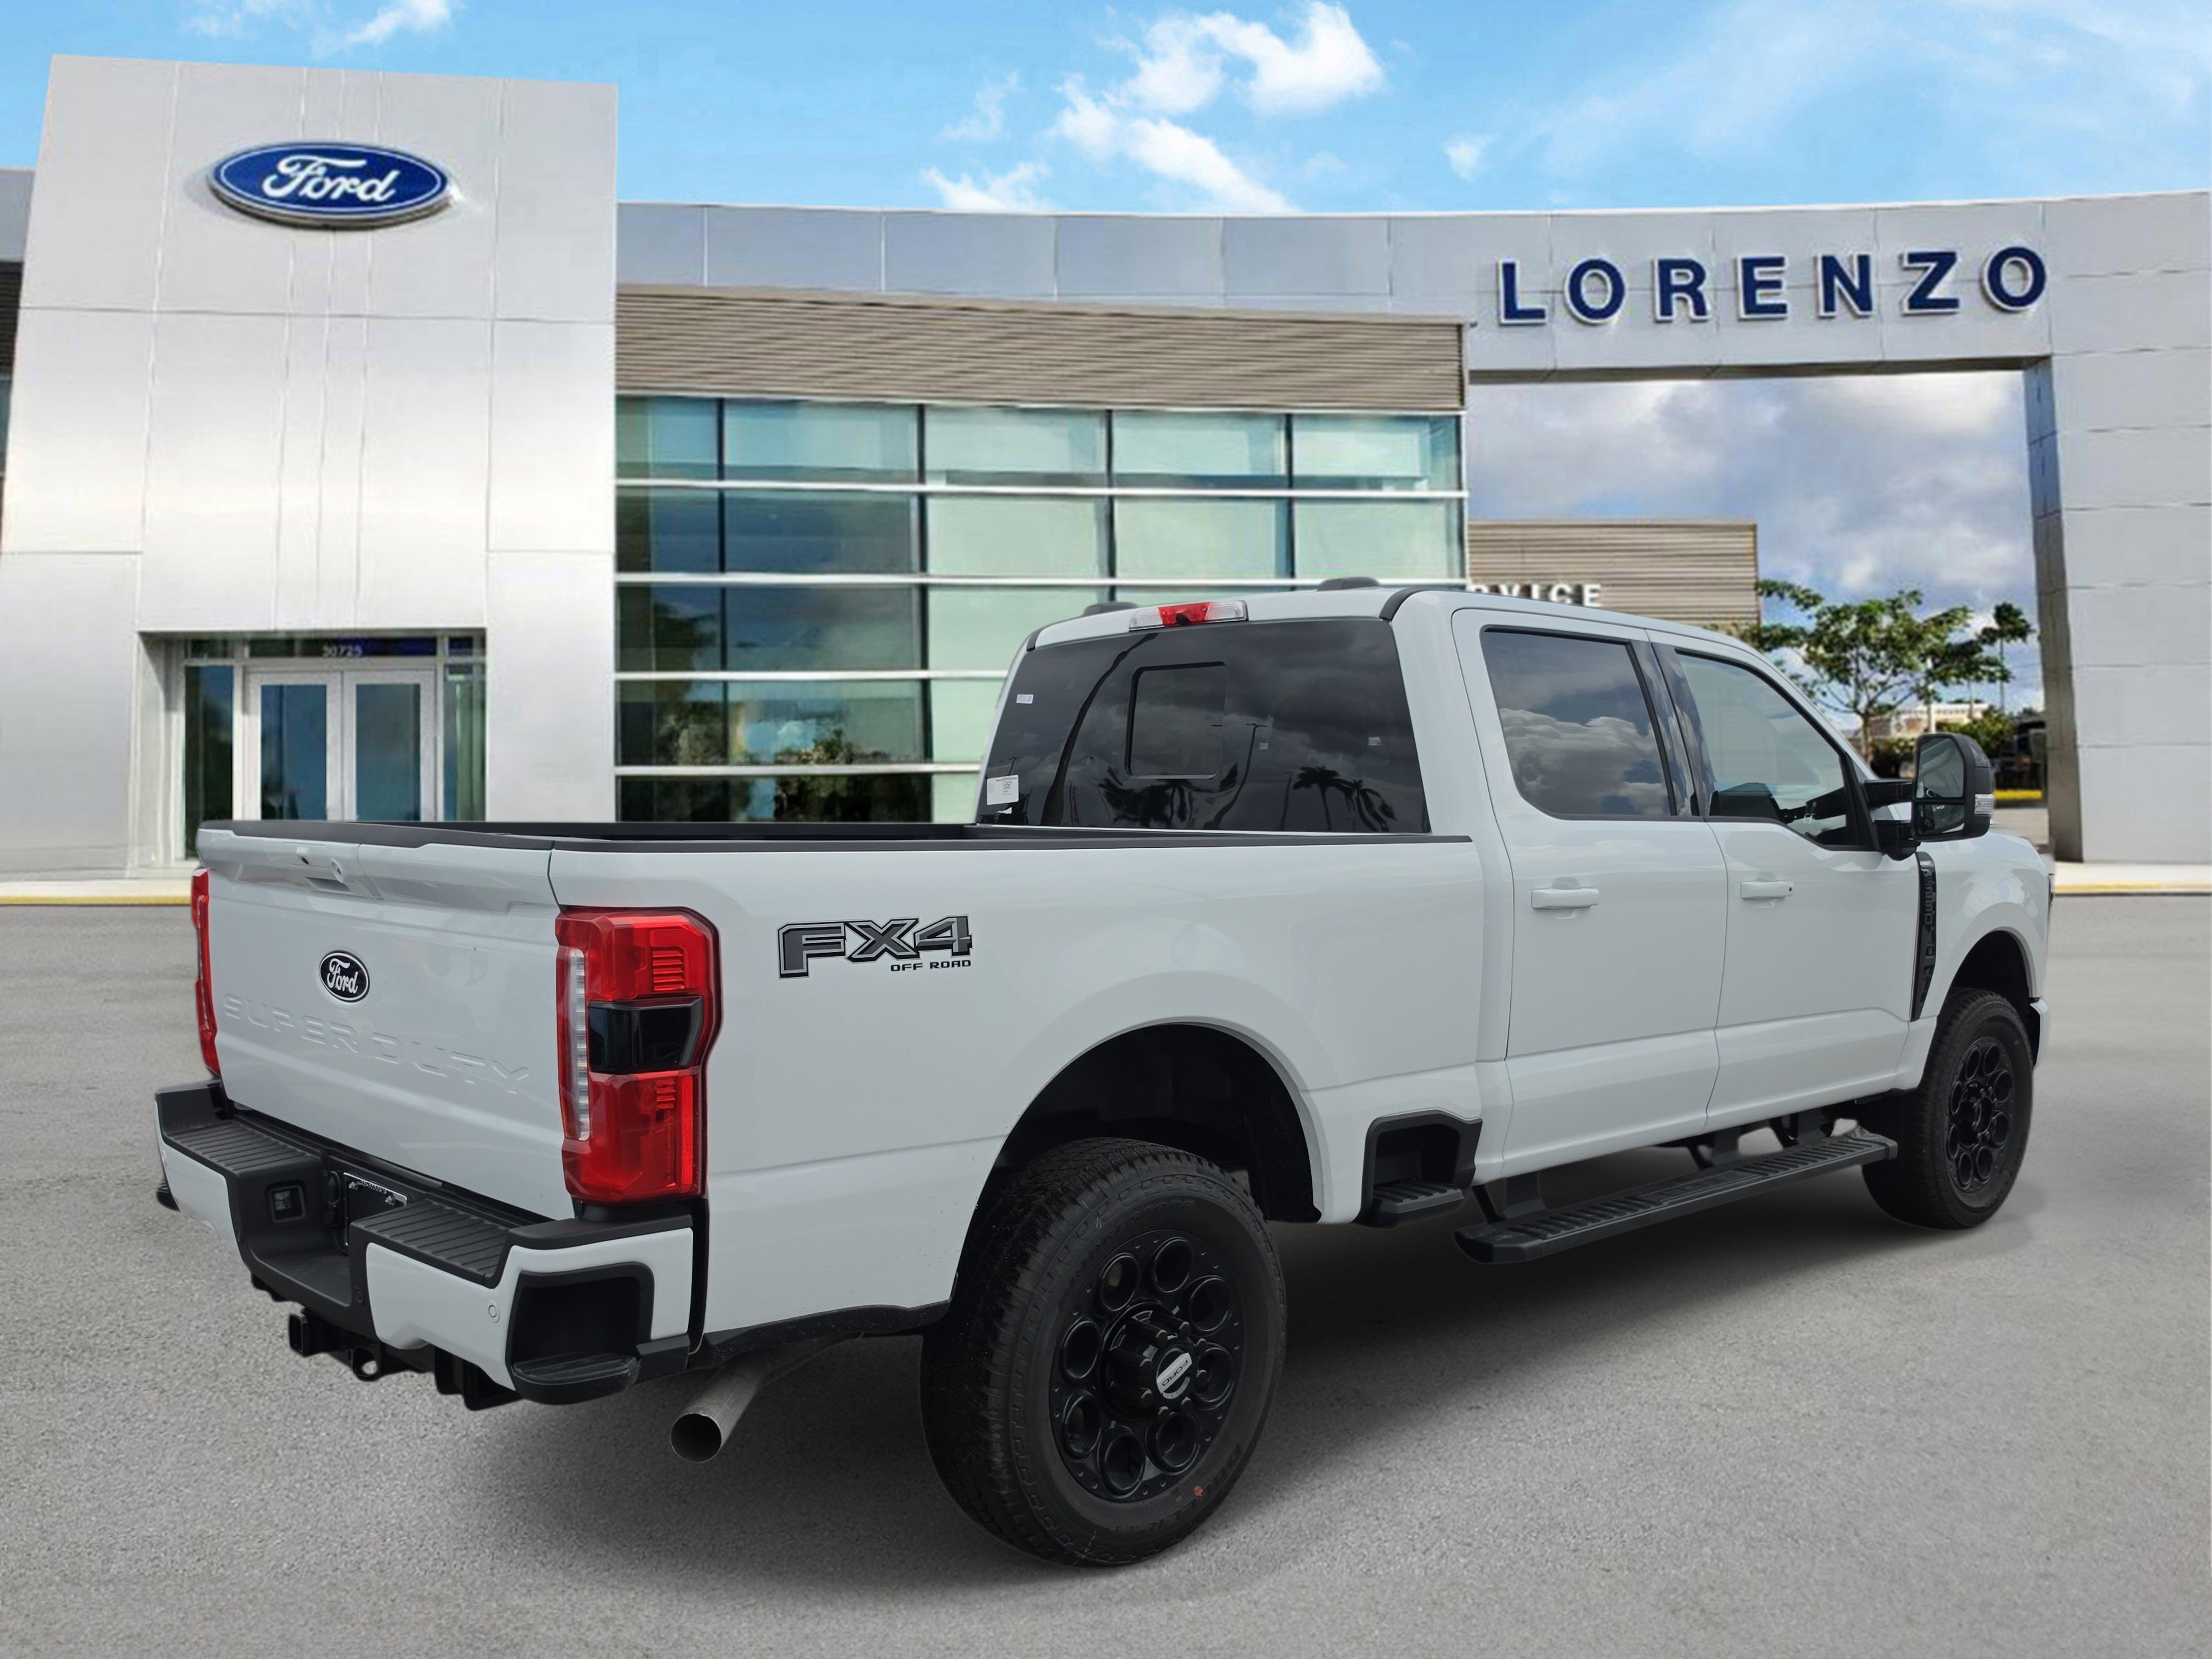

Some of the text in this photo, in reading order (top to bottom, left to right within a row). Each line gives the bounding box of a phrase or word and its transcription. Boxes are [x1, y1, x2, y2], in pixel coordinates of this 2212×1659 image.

[262, 154, 401, 202] Ford
[1497, 246, 2047, 324] LORENZO
[777, 914, 973, 980] FX4
[890, 960, 972, 972] OFF ROAD
[326, 958, 359, 995] Ford
[224, 994, 529, 1094] SUPER DUTY
[1162, 1360, 1188, 1386] FORD
